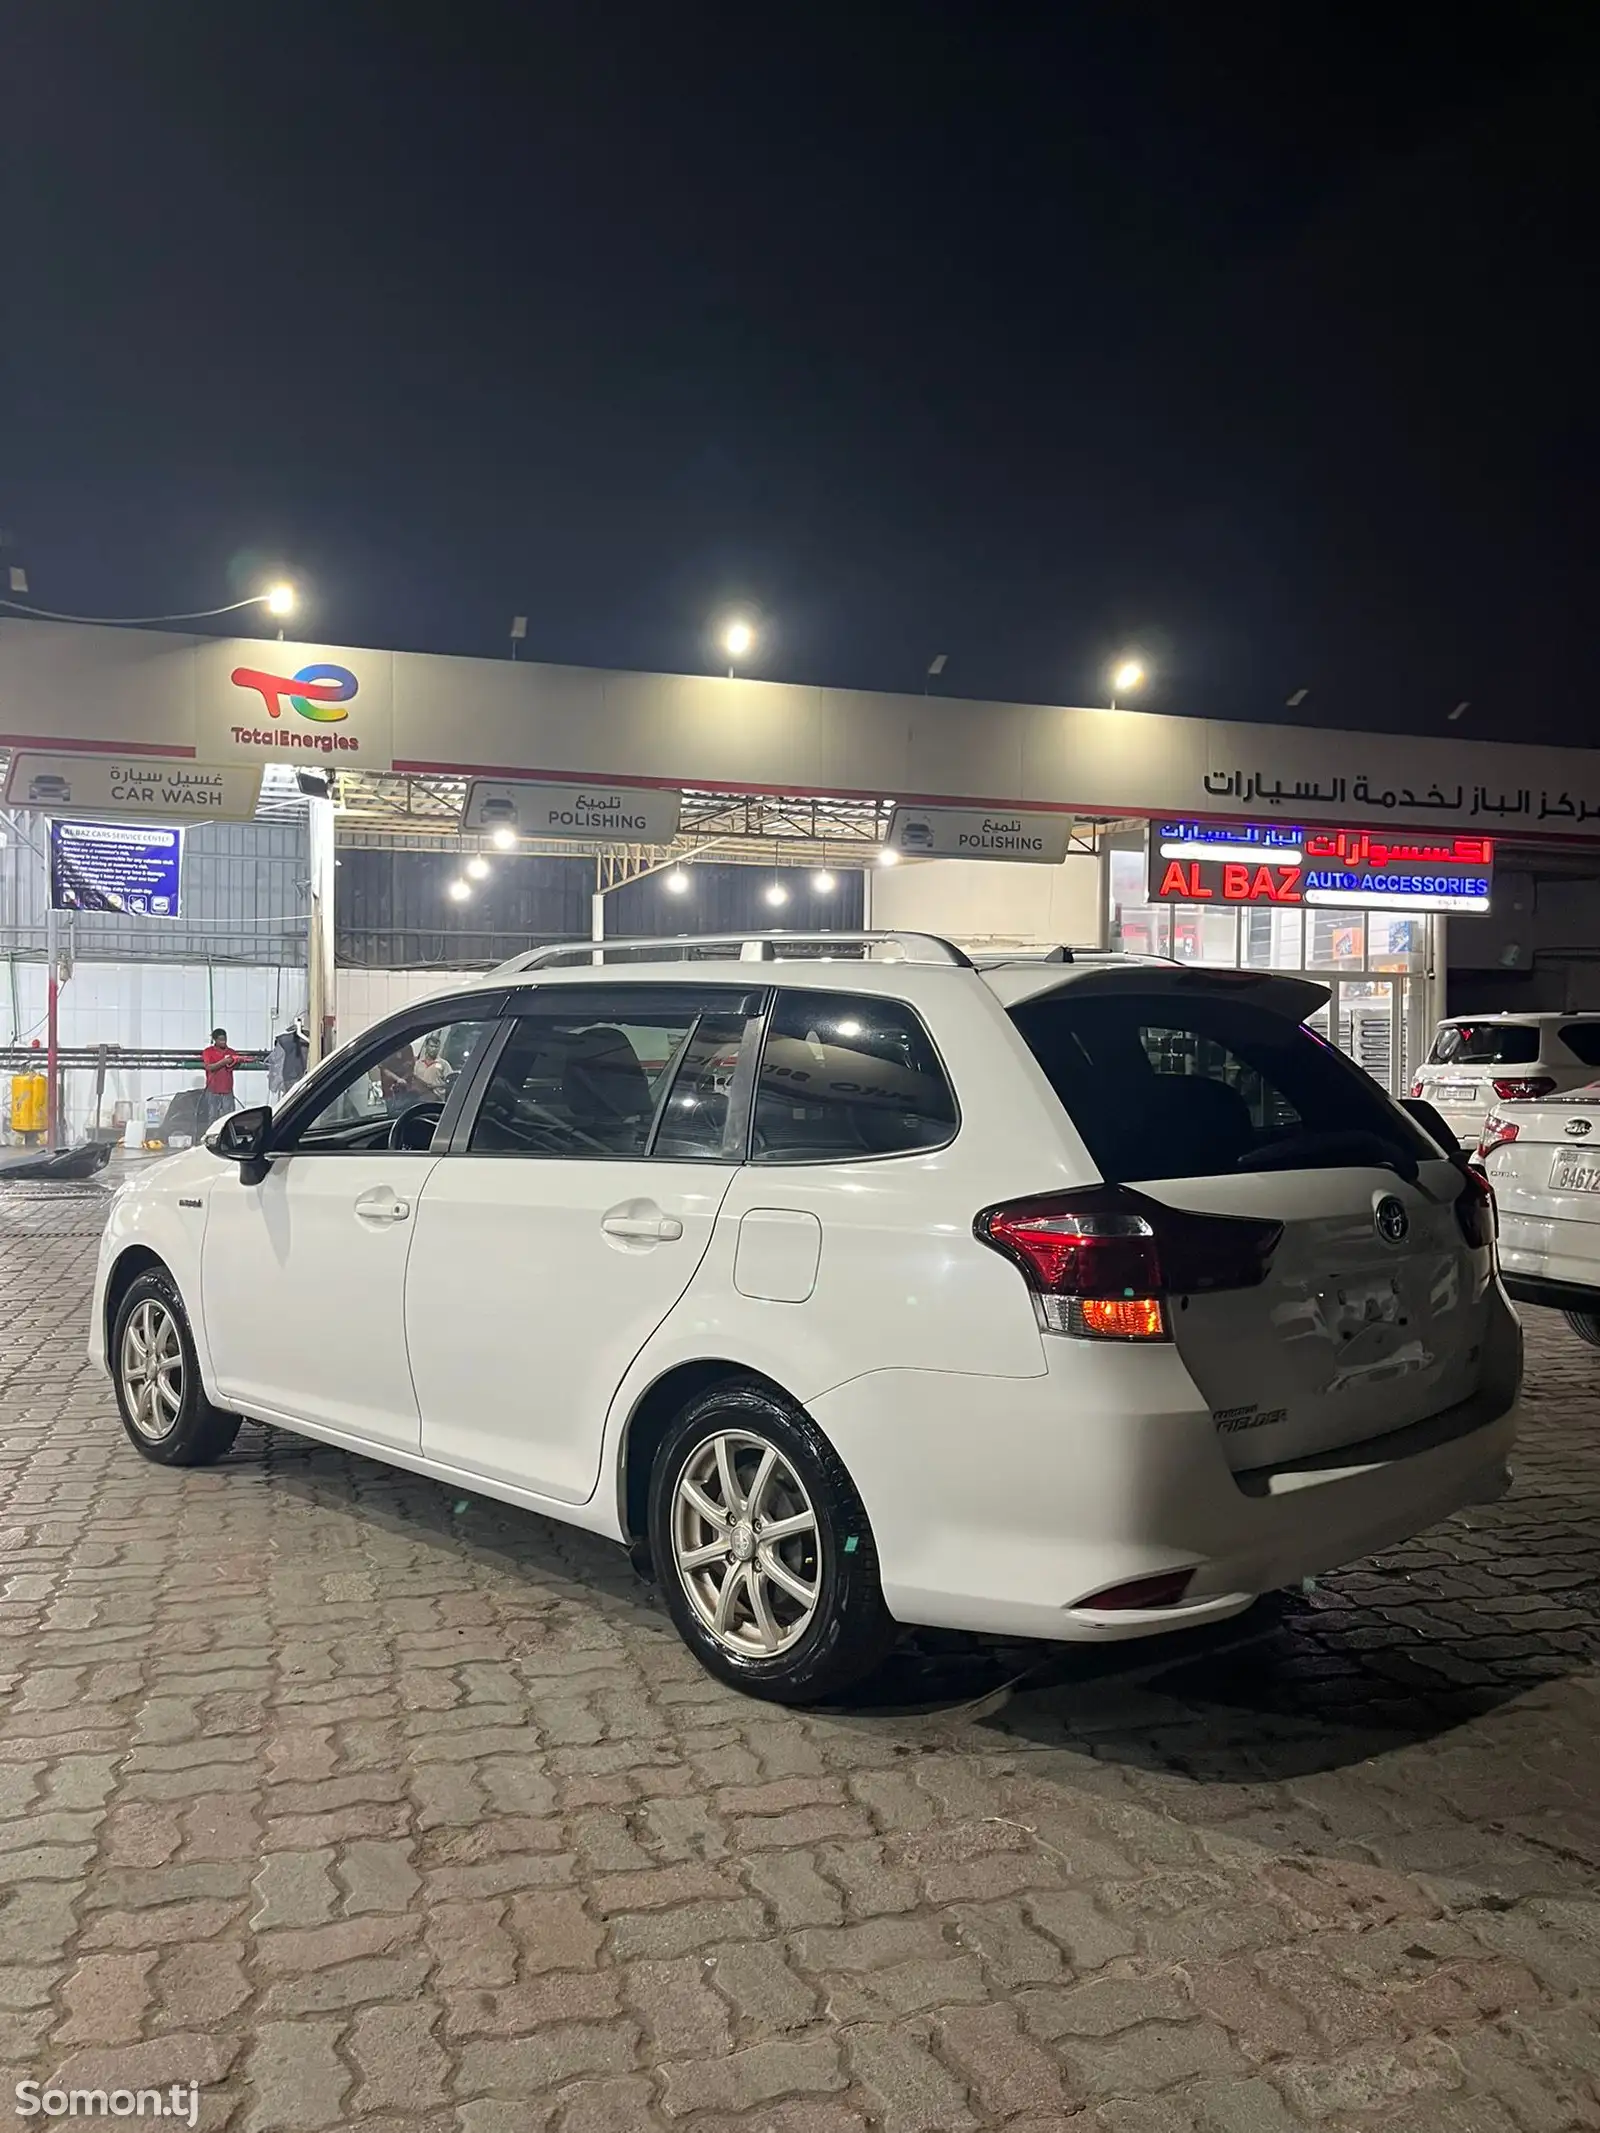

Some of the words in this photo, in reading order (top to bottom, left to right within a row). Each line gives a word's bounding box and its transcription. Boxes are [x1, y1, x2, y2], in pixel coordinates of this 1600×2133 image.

[230, 726, 359, 752] TotalEnergies
[110, 766, 162, 784] سيارة
[168, 773, 223, 788] غسيل
[111, 786, 154, 802] CAR
[161, 788, 223, 806] WASH
[1203, 770, 1346, 804] السيارات
[1353, 775, 1462, 809] لخدمة
[575, 795, 622, 811] تلميع
[1470, 786, 1530, 817] الباز
[1537, 791, 1600, 823] ركز
[548, 811, 647, 830] POLISHING
[982, 818, 1022, 833] تلميع
[75, 829, 90, 837] BAZ
[92, 830, 111, 838] CARS
[112, 832, 142, 841] SERVICE
[958, 833, 1043, 851] POLISHING
[1262, 827, 1303, 846] الباز
[1305, 832, 1492, 867] اكسسوارات
[1159, 861, 1213, 897] AL
[1223, 864, 1302, 901] BAZ
[1305, 870, 1358, 889] AUTO
[1361, 873, 1489, 896] ACCESSORIES
